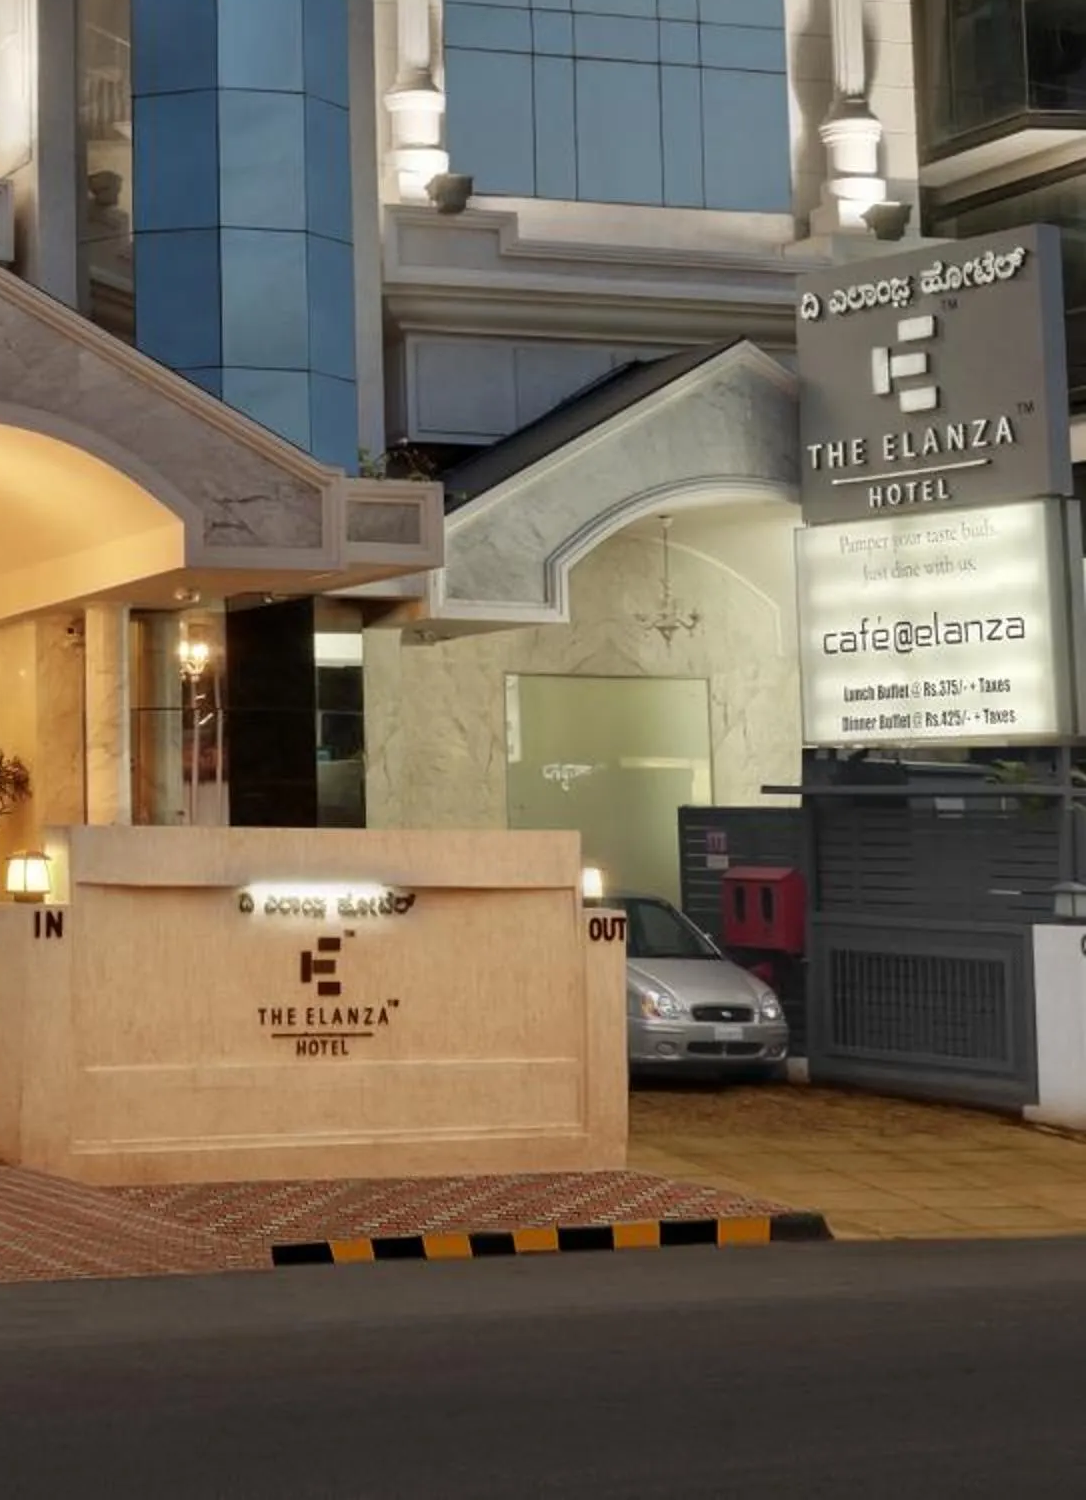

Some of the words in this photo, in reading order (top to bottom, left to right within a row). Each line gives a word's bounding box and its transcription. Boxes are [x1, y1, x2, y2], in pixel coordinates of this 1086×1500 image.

[807, 438, 865, 469] THE
[883, 416, 1015, 462] ELANZA
[868, 478, 951, 507] HOTEL
[926, 528, 957, 544] taste
[891, 561, 920, 579] dine
[924, 555, 954, 577] with
[822, 612, 1026, 655] café@elanza
[843, 685, 875, 703] Lunch
[877, 683, 909, 700] Buffet
[978, 677, 1011, 693] Taxes
[842, 716, 877, 732] Dinner
[879, 713, 911, 730] Buffet
[34, 910, 63, 939] IN
[588, 917, 627, 942] OUT
[257, 1007, 296, 1026] THE
[306, 1006, 389, 1026] ELANZA
[295, 1039, 350, 1057] HOTEL
